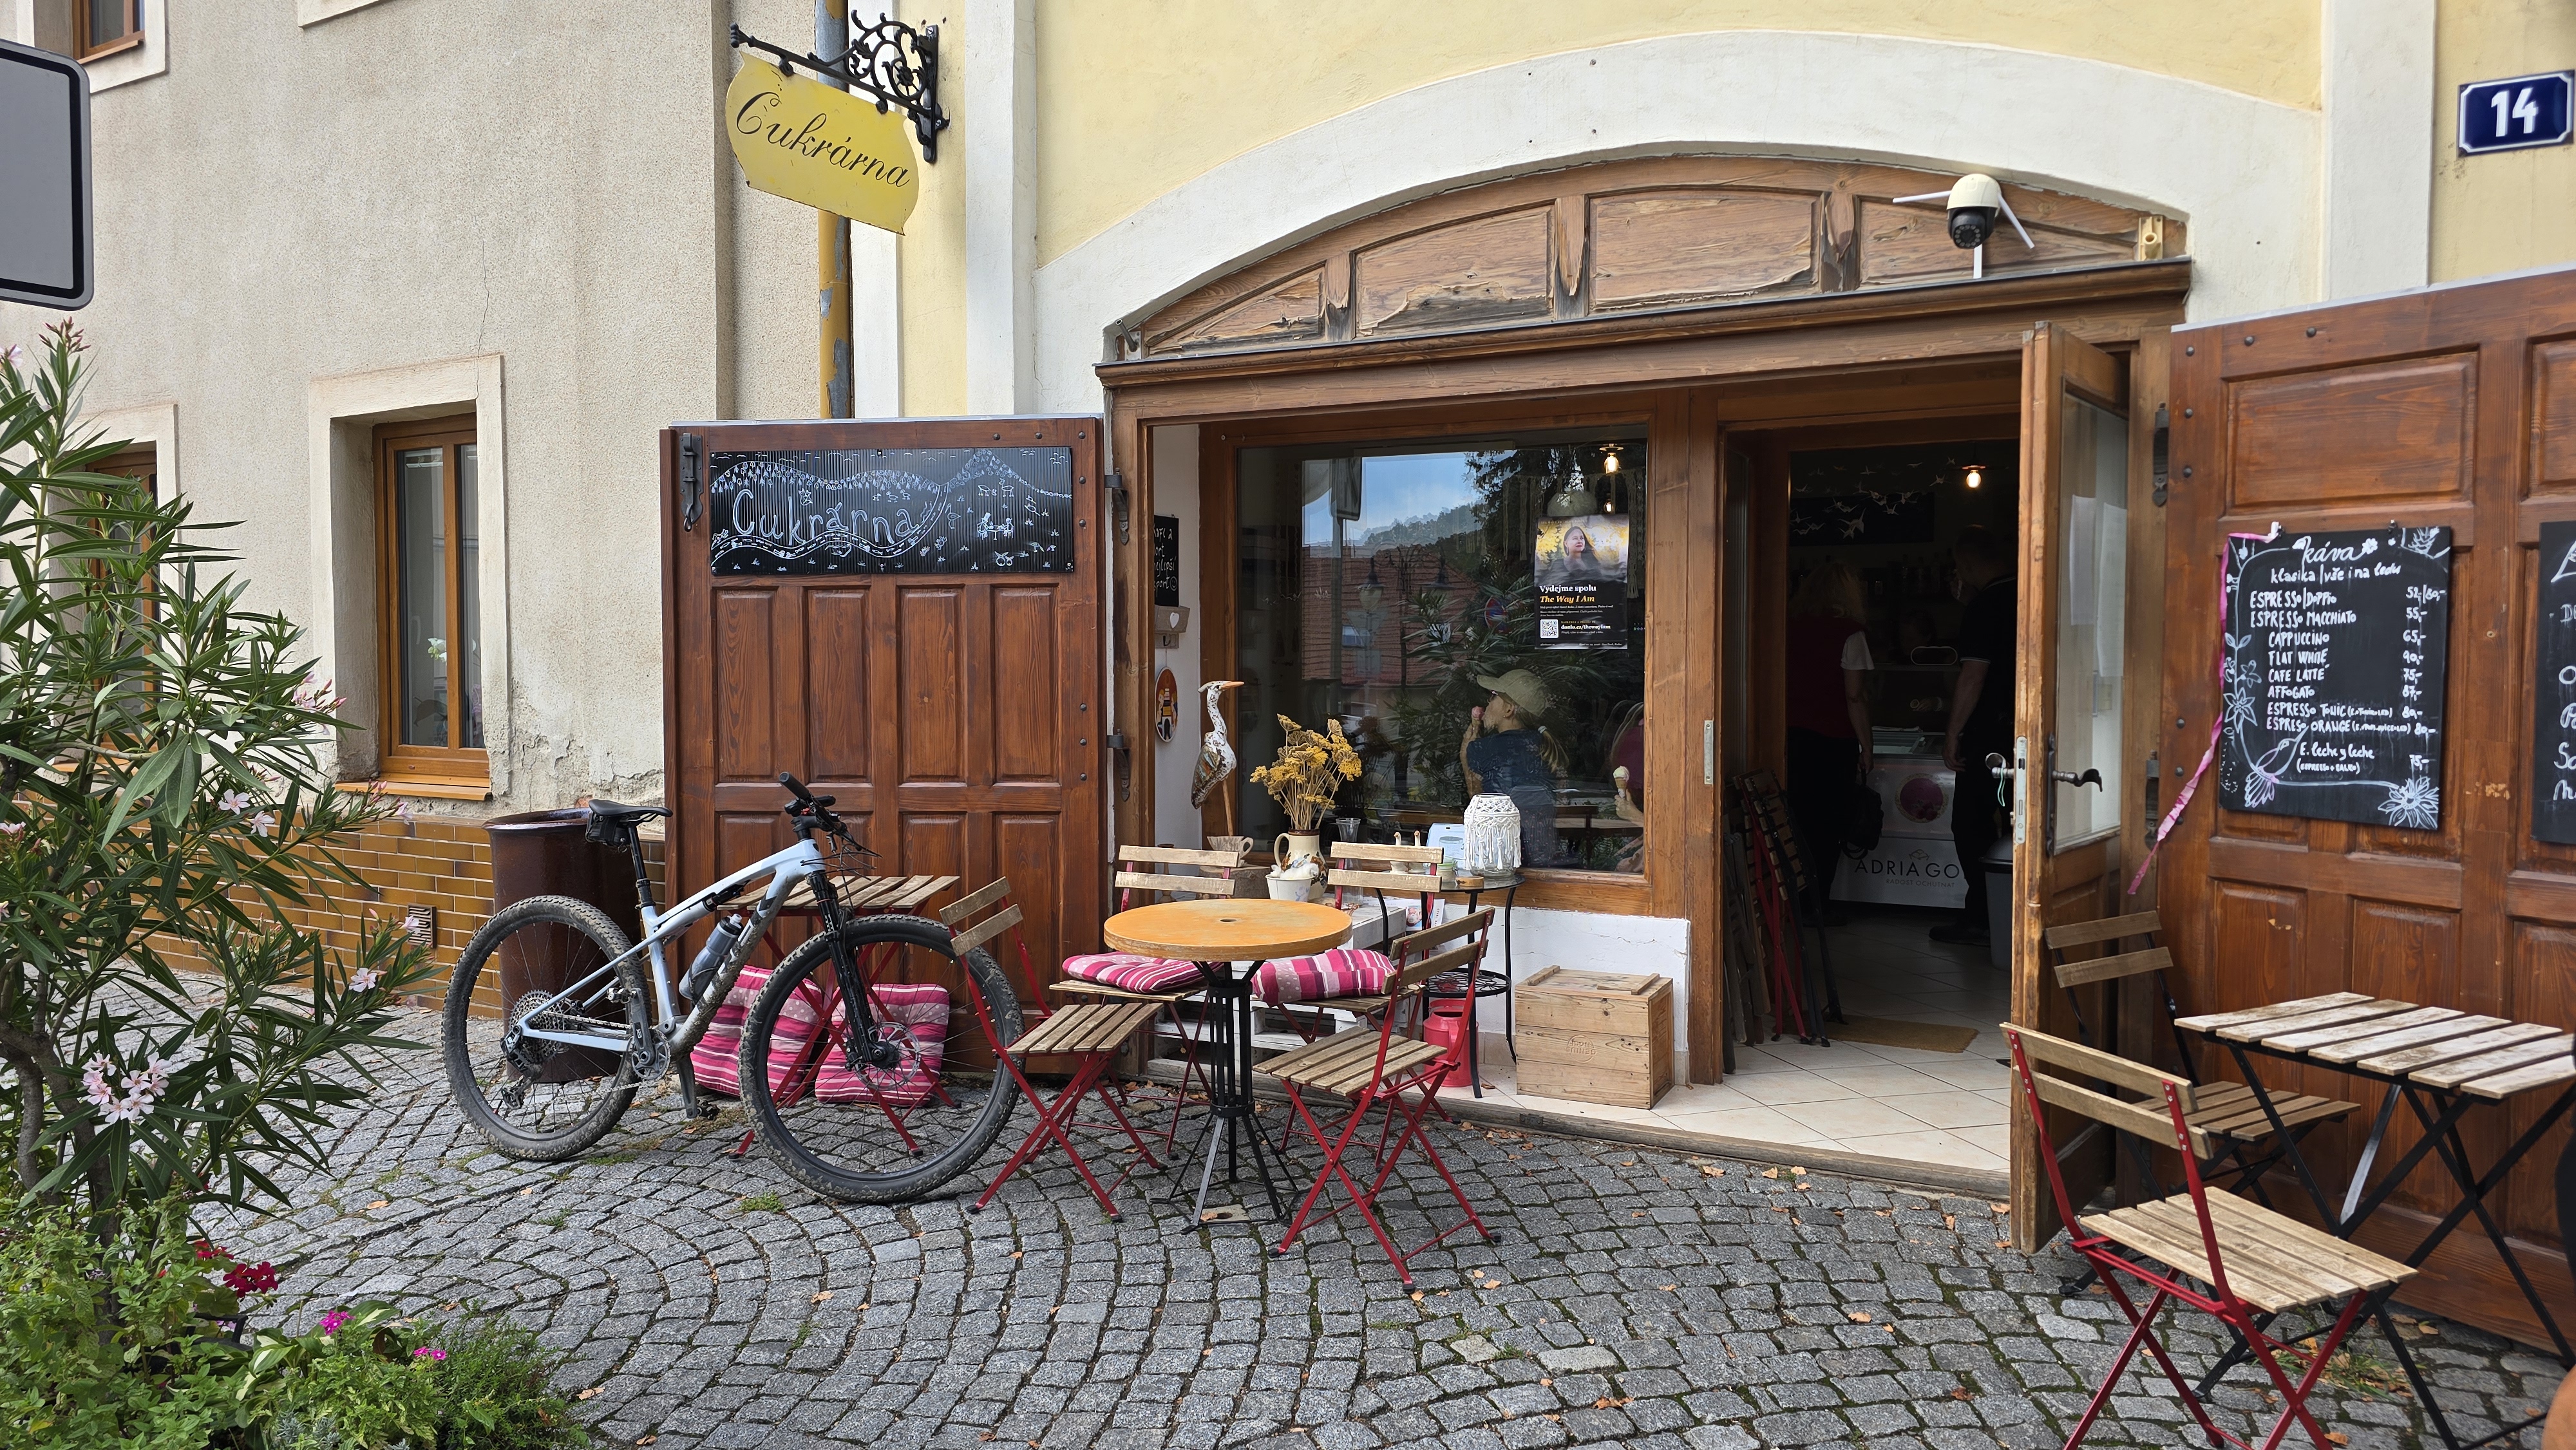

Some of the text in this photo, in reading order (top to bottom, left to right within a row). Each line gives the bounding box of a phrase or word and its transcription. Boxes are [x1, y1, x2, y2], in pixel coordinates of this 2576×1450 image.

[2490, 87, 2539, 137] 14
[736, 91, 911, 187] Cukrárna
[732, 488, 920, 546] Cukrárna
[2299, 536, 2365, 565] káva
[2270, 567, 2316, 583] klasika
[2374, 561, 2402, 576] ledu
[1575, 584, 1596, 593] spolu
[1556, 595, 1575, 604] Way
[2250, 610, 2304, 628] ESPRESSO
[2306, 609, 2357, 628] MACCHIATO
[2268, 629, 2330, 648] CAPPUCCINO
[2268, 650, 2293, 667] FLAT
[2297, 648, 2329, 664] WHITE
[2268, 668, 2291, 683] CAFE
[2267, 684, 2315, 699] AFFOGATO
[2266, 701, 2316, 718] ESPRESSO
[2310, 719, 2351, 733] ORANGE
[2311, 741, 2338, 757] leche
[2347, 743, 2375, 759] leche
[1915, 880, 1955, 889] OCHUTNAT
